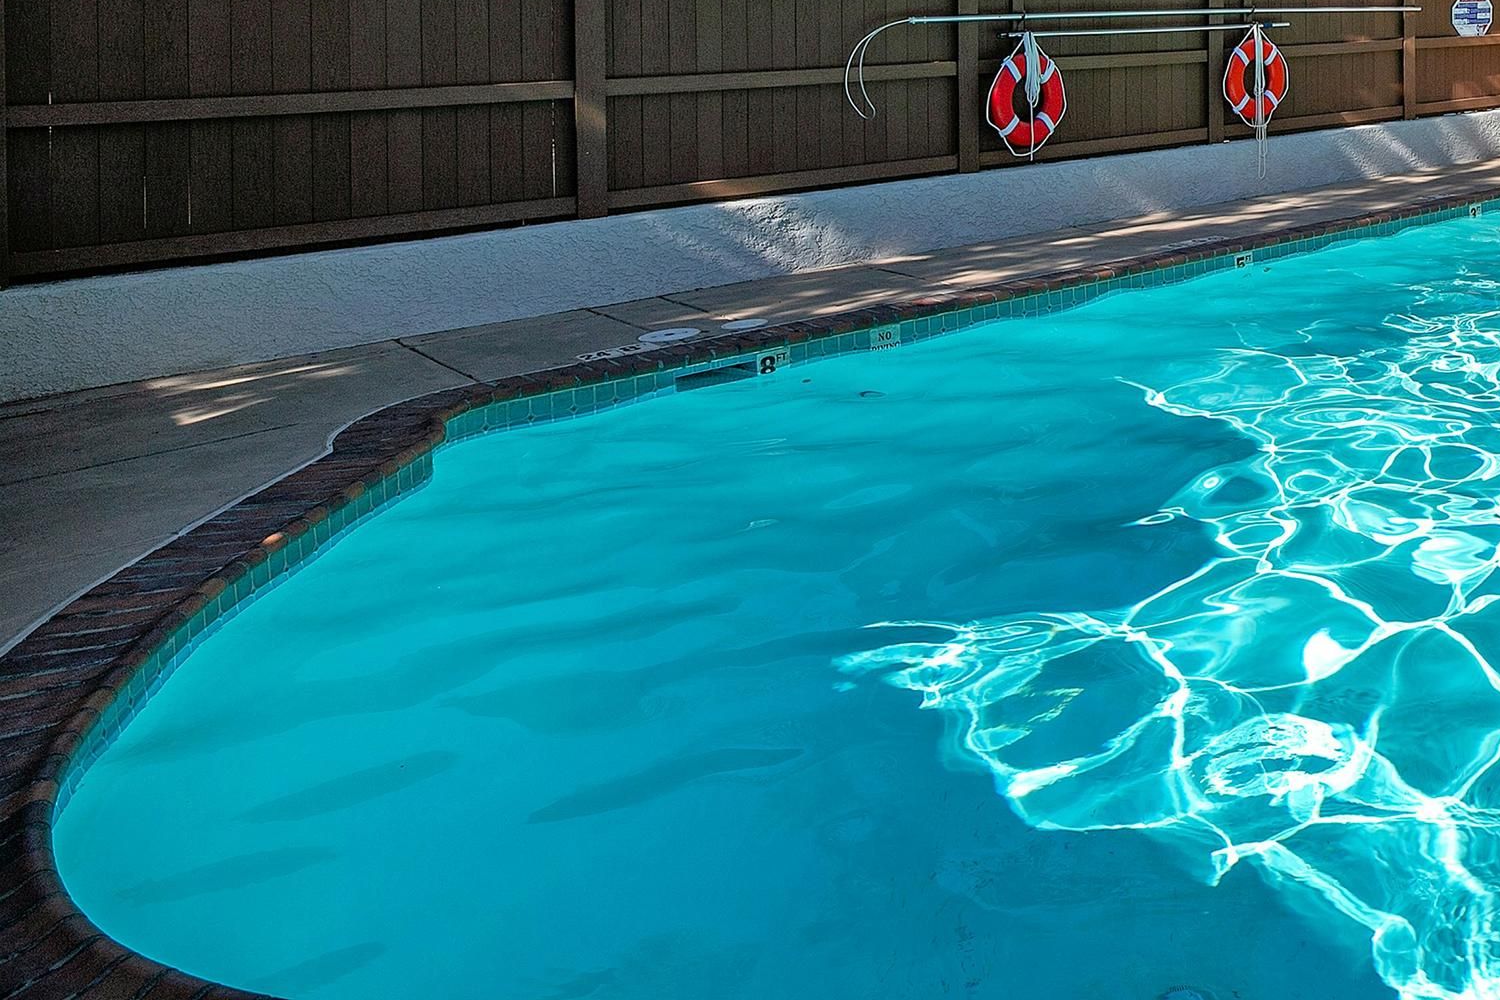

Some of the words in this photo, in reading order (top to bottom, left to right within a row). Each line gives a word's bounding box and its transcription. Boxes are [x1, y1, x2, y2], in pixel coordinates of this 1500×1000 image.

[878, 330, 892, 342] NO
[760, 355, 776, 375] 8
[776, 352, 787, 362] FT
